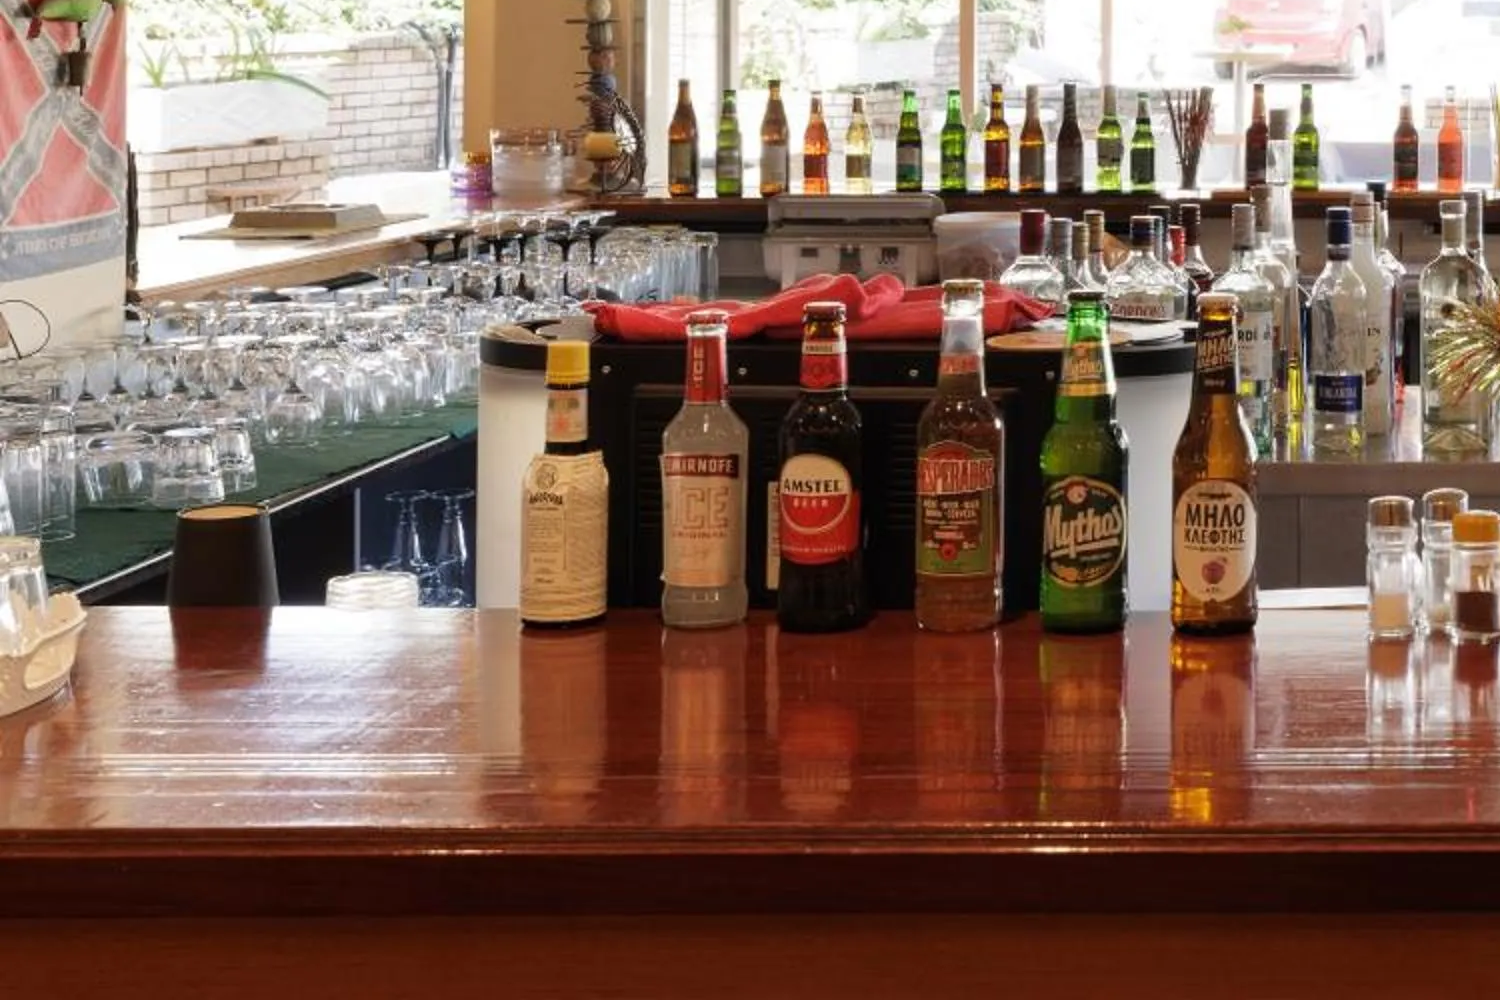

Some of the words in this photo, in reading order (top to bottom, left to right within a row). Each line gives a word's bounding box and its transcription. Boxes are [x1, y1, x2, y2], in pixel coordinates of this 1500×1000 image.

[783, 478, 841, 493] AMSTEL
[672, 486, 729, 530] ICE
[792, 497, 829, 508] BEER
[1184, 503, 1245, 528] ΜΗΛΟ
[1043, 503, 1123, 559] Mythos
